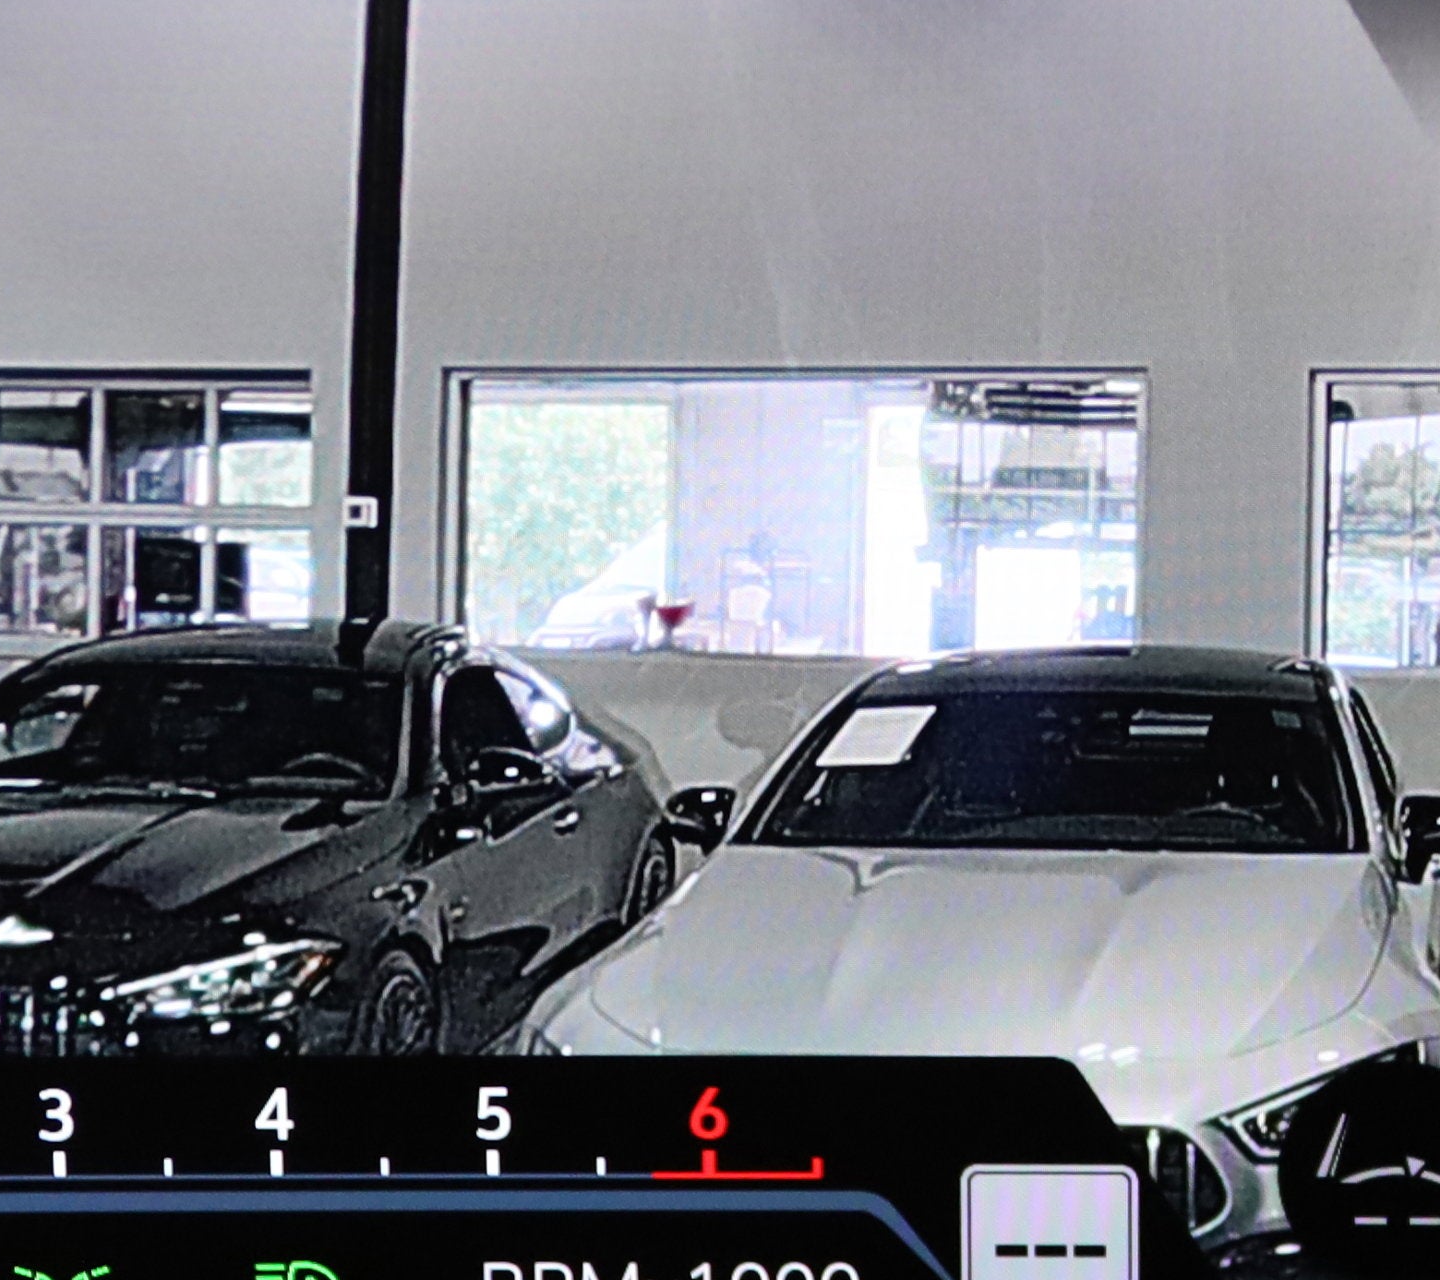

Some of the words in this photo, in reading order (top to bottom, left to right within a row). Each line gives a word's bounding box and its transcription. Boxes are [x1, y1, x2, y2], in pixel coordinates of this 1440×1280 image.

[39, 1088, 74, 1142] 3
[255, 1087, 294, 1140] 4
[476, 1087, 511, 1140] 5
[690, 1087, 728, 1140] 6
